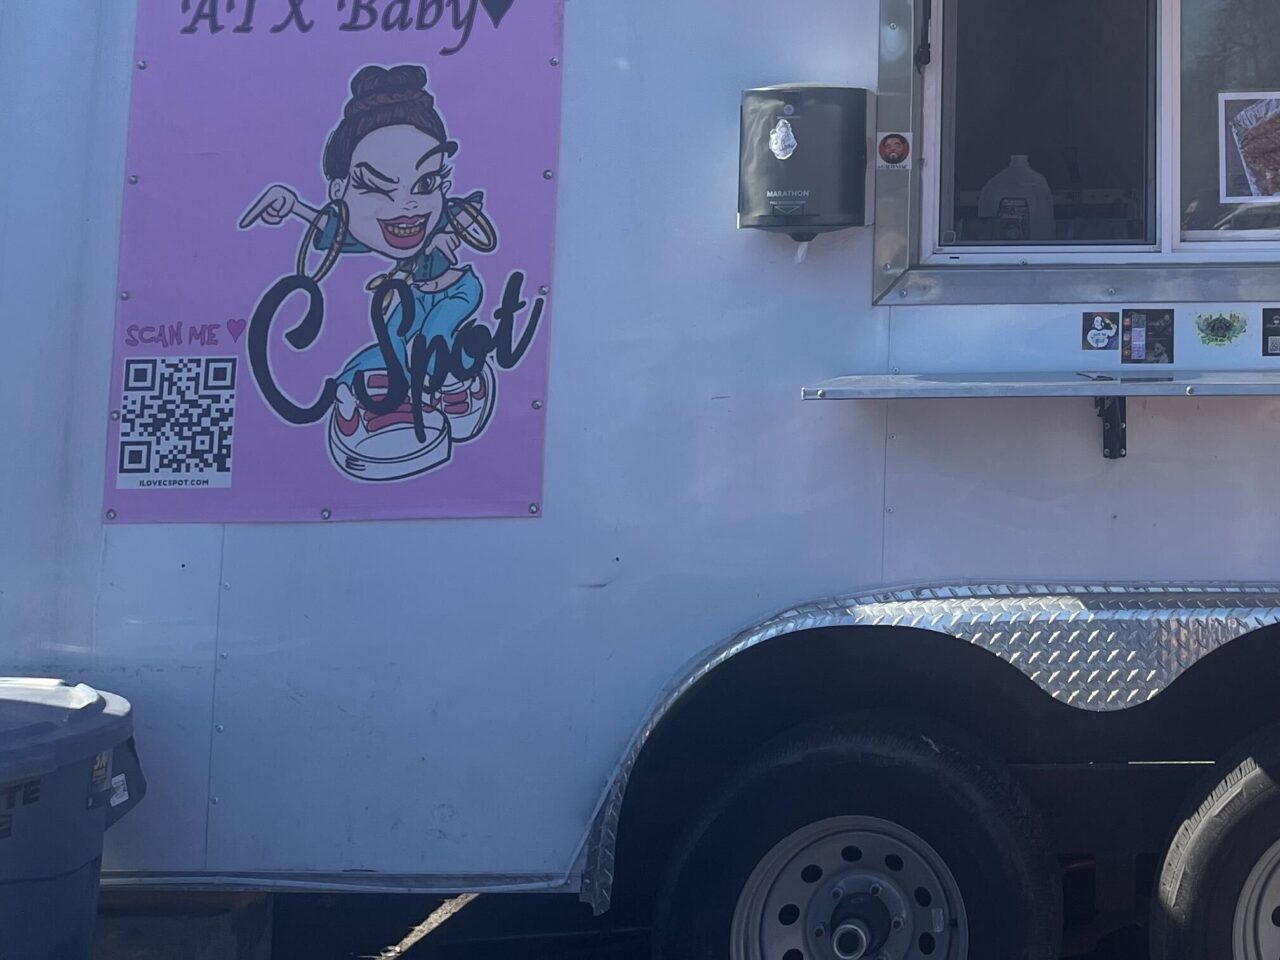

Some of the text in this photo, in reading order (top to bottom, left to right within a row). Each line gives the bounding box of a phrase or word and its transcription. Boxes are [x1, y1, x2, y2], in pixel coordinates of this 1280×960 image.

[125, 322, 220, 348] SCAN ME
[249, 272, 544, 443] C Spot
